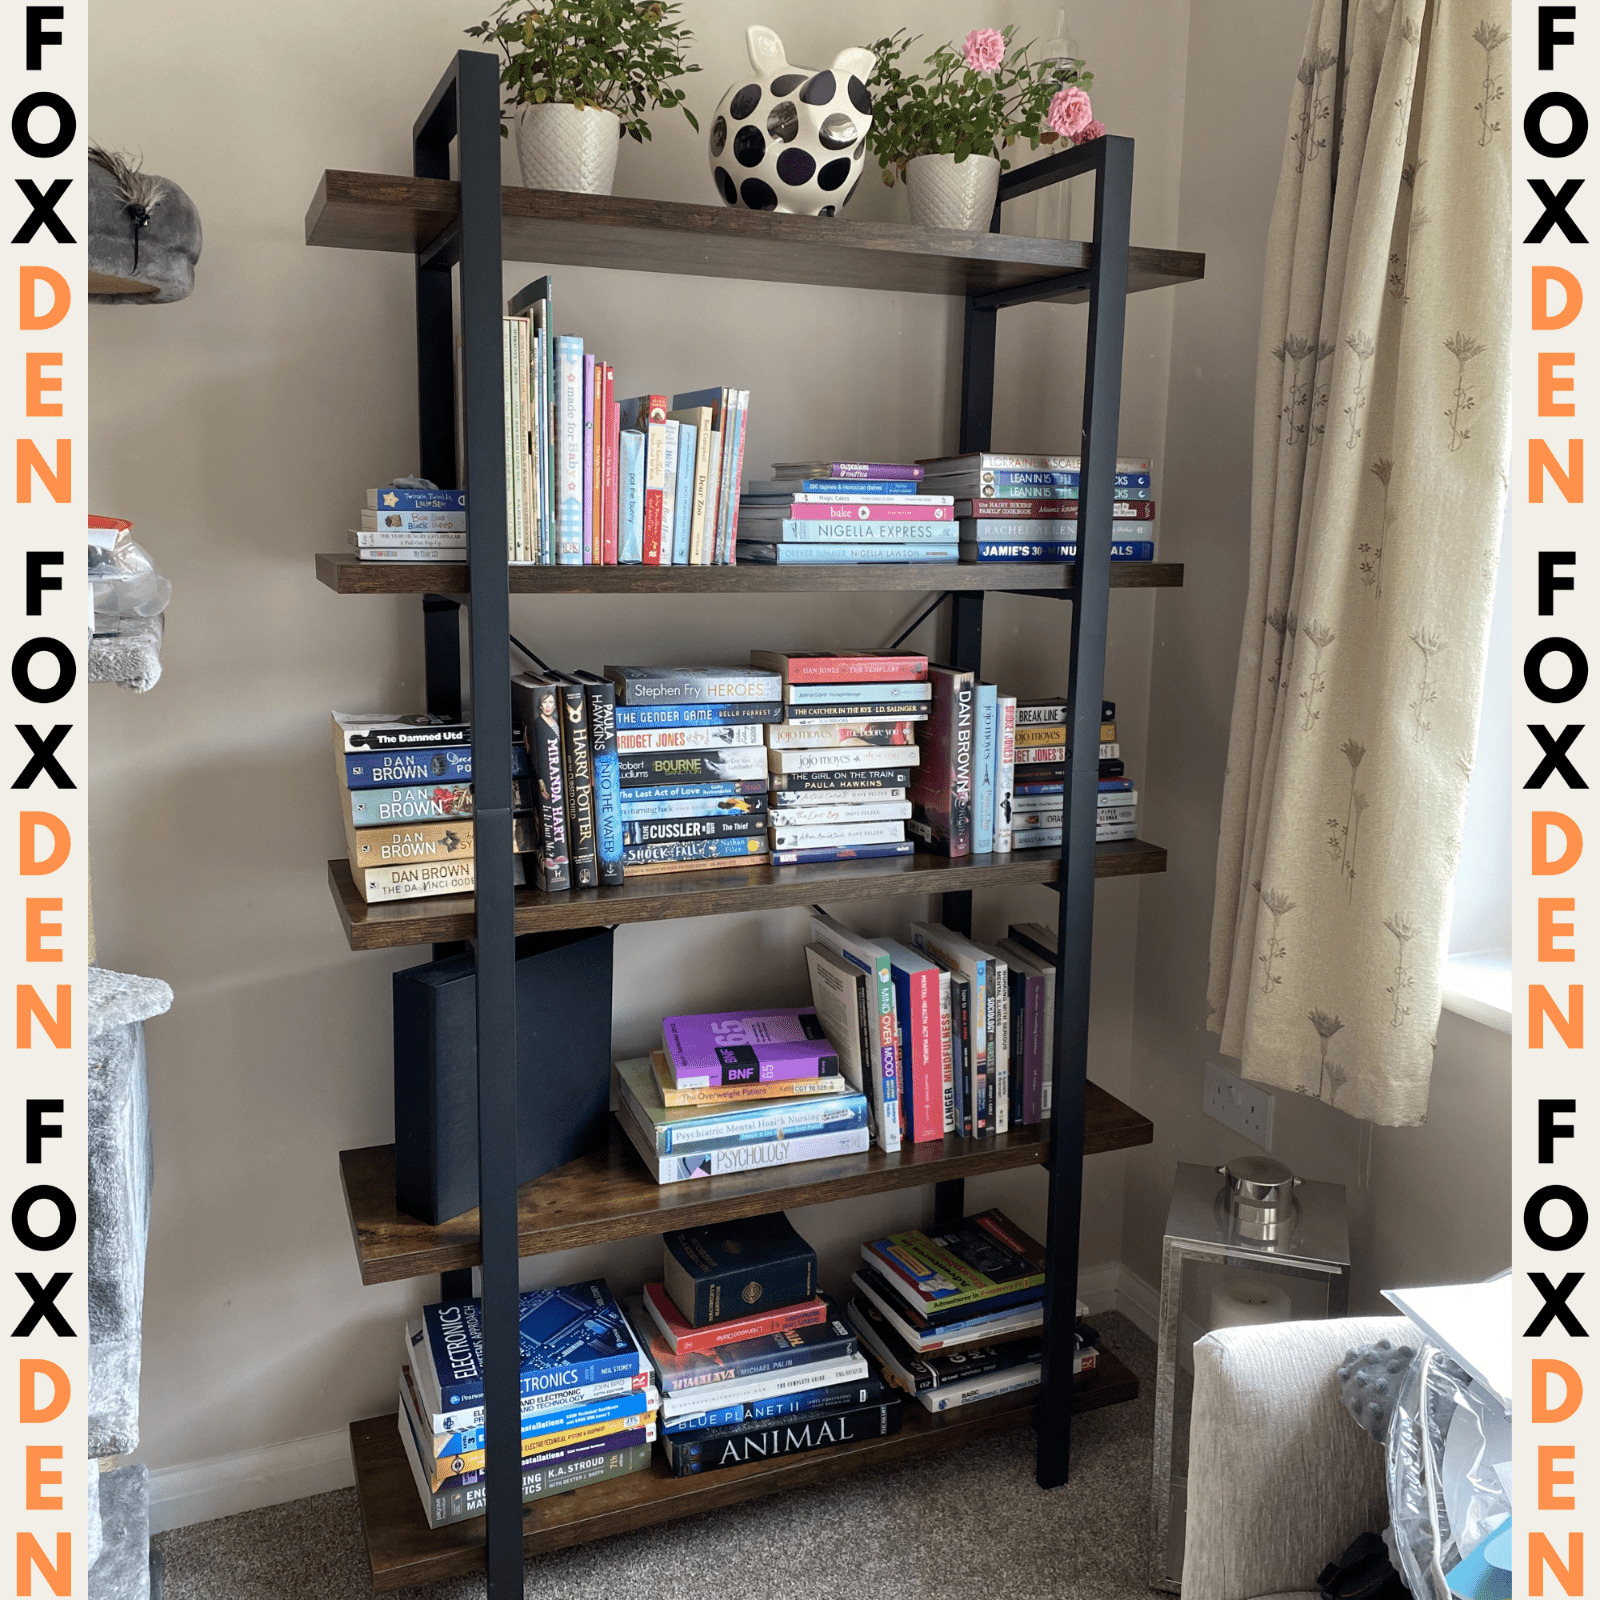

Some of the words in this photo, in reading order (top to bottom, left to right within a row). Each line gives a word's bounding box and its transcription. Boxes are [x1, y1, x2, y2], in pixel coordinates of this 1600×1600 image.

[567, 387, 577, 418] made
[567, 423, 577, 440] for
[566, 443, 579, 478] Baby
[628, 473, 636, 485] pat
[698, 475, 706, 498] Dear
[1010, 473, 1033, 483] LEAN
[1033, 474, 1042, 484] IN
[1043, 474, 1051, 484] 15
[1010, 487, 1033, 497] LEAN
[1033, 487, 1042, 497] IN
[1043, 488, 1051, 497] 15
[628, 501, 636, 523] bunny
[696, 500, 705, 516] Zoo
[830, 506, 852, 518] bake
[408, 521, 428, 529] Black
[818, 524, 874, 538] NIGELLA
[880, 525, 932, 538] EXPRESS
[983, 546, 1030, 556] JAMIE'S
[635, 684, 680, 699] Stephen
[684, 683, 701, 698] Fry
[707, 684, 764, 696] HEROES
[617, 713, 636, 723] THE
[640, 711, 680, 722] GENDER
[683, 710, 712, 720] GAME
[958, 691, 971, 726] DAN
[982, 705, 993, 725] jojo
[1020, 710, 1040, 721] BREAK
[1043, 710, 1059, 720] LINE
[592, 694, 606, 751] HAWKINS
[603, 703, 615, 740] PAULA
[1004, 706, 1015, 734] BRIDGET
[377, 735, 396, 743] The
[400, 733, 441, 742] Damned
[443, 732, 463, 740] Utd
[777, 729, 797, 743] jojo
[800, 729, 833, 741] moyes
[983, 727, 992, 760] moyes
[1031, 731, 1060, 740] moyes
[573, 729, 590, 779] HARRY
[1003, 735, 1014, 764] JONES'S
[1033, 748, 1063, 761] JONES'S
[383, 756, 415, 767] DAN
[654, 759, 701, 772] BOURNE
[799, 755, 818, 769] jojo
[820, 754, 851, 766] moyes
[957, 729, 970, 793] BROWN
[373, 765, 428, 781] BROWN
[547, 738, 561, 802] MIRANDA
[600, 761, 612, 790] INTO
[567, 772, 576, 798] CURSED
[620, 791, 633, 799] The
[635, 790, 652, 798] Last
[654, 789, 668, 797] Act
[670, 788, 679, 796] of
[681, 787, 700, 795] Love
[393, 788, 428, 802] DAN
[602, 794, 613, 813] THE
[379, 800, 443, 819] BROWN
[576, 784, 592, 844] POTTER
[552, 805, 565, 843] HART
[650, 822, 701, 838] CUSSLER
[734, 822, 749, 830] Thief
[393, 832, 423, 844] DAN
[603, 819, 615, 854] WATER
[381, 842, 436, 859] BROWN
[628, 847, 668, 861] SHOCK
[675, 845, 700, 857] FALL
[392, 869, 418, 884] DAN
[422, 864, 469, 880] BROWN
[881, 987, 891, 1014] MIND
[882, 1016, 892, 1045] OVER
[922, 1039, 930, 1066] MANUAL
[942, 1013, 953, 1082] MINDFULNESS
[884, 1047, 894, 1077] MOOD
[728, 1068, 754, 1080] BNF
[682, 1093, 697, 1101] The
[698, 1089, 740, 1101] Overweight
[742, 1087, 766, 1096] Patient
[944, 1087, 954, 1126] LANGER
[676, 1127, 724, 1141] Psychiatric
[726, 1123, 758, 1134] Mental
[788, 1115, 821, 1127] Nursing
[716, 1142, 790, 1169] PSYCHOLOGY
[439, 1306, 478, 1380] ELECTRONICS
[601, 1367, 616, 1375] NEIL
[617, 1363, 633, 1373] STOREY
[672, 1368, 735, 1390] HIMALAYA
[740, 1362, 770, 1375] MICHAEL
[772, 1359, 792, 1369] PALIN
[592, 1383, 608, 1392] JOHN
[609, 1380, 625, 1389] BIRD
[920, 1381, 931, 1389] CGP
[961, 1389, 979, 1398] BASIC
[535, 1394, 584, 1411] TECHNOLOGY
[538, 1388, 581, 1403] ELECTRONIC
[625, 1415, 638, 1424] JTL
[678, 1414, 717, 1430] BLUE
[725, 1404, 786, 1422] PLANET
[790, 1401, 799, 1411] II
[718, 1417, 854, 1464] ANIMAL
[548, 1466, 567, 1479] K.A.
[568, 1457, 604, 1473] STROUD
[609, 1454, 618, 1469] 7th
